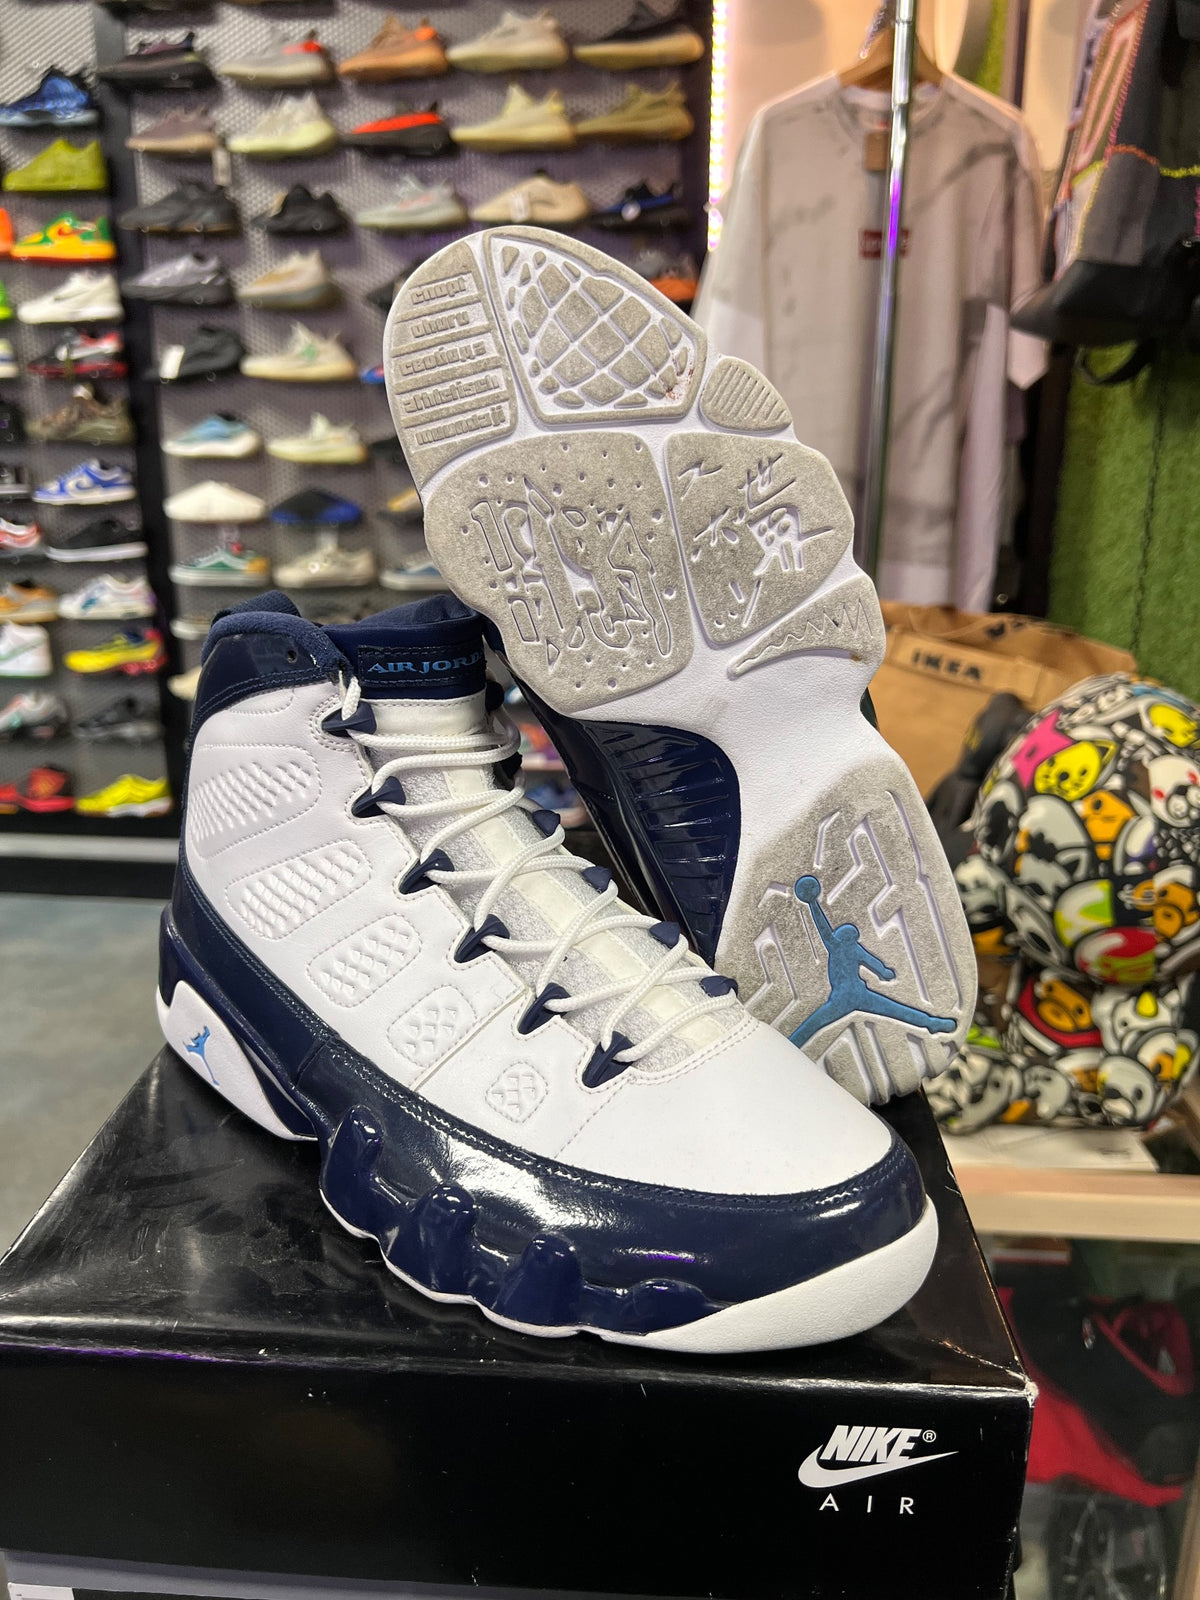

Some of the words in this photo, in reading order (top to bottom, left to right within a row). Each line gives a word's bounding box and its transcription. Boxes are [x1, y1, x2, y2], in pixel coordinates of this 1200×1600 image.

[367, 662, 417, 674] AIR
[911, 650, 981, 680] IKEA
[820, 1424, 922, 1463] NIKE
[819, 1493, 914, 1515] AIR
